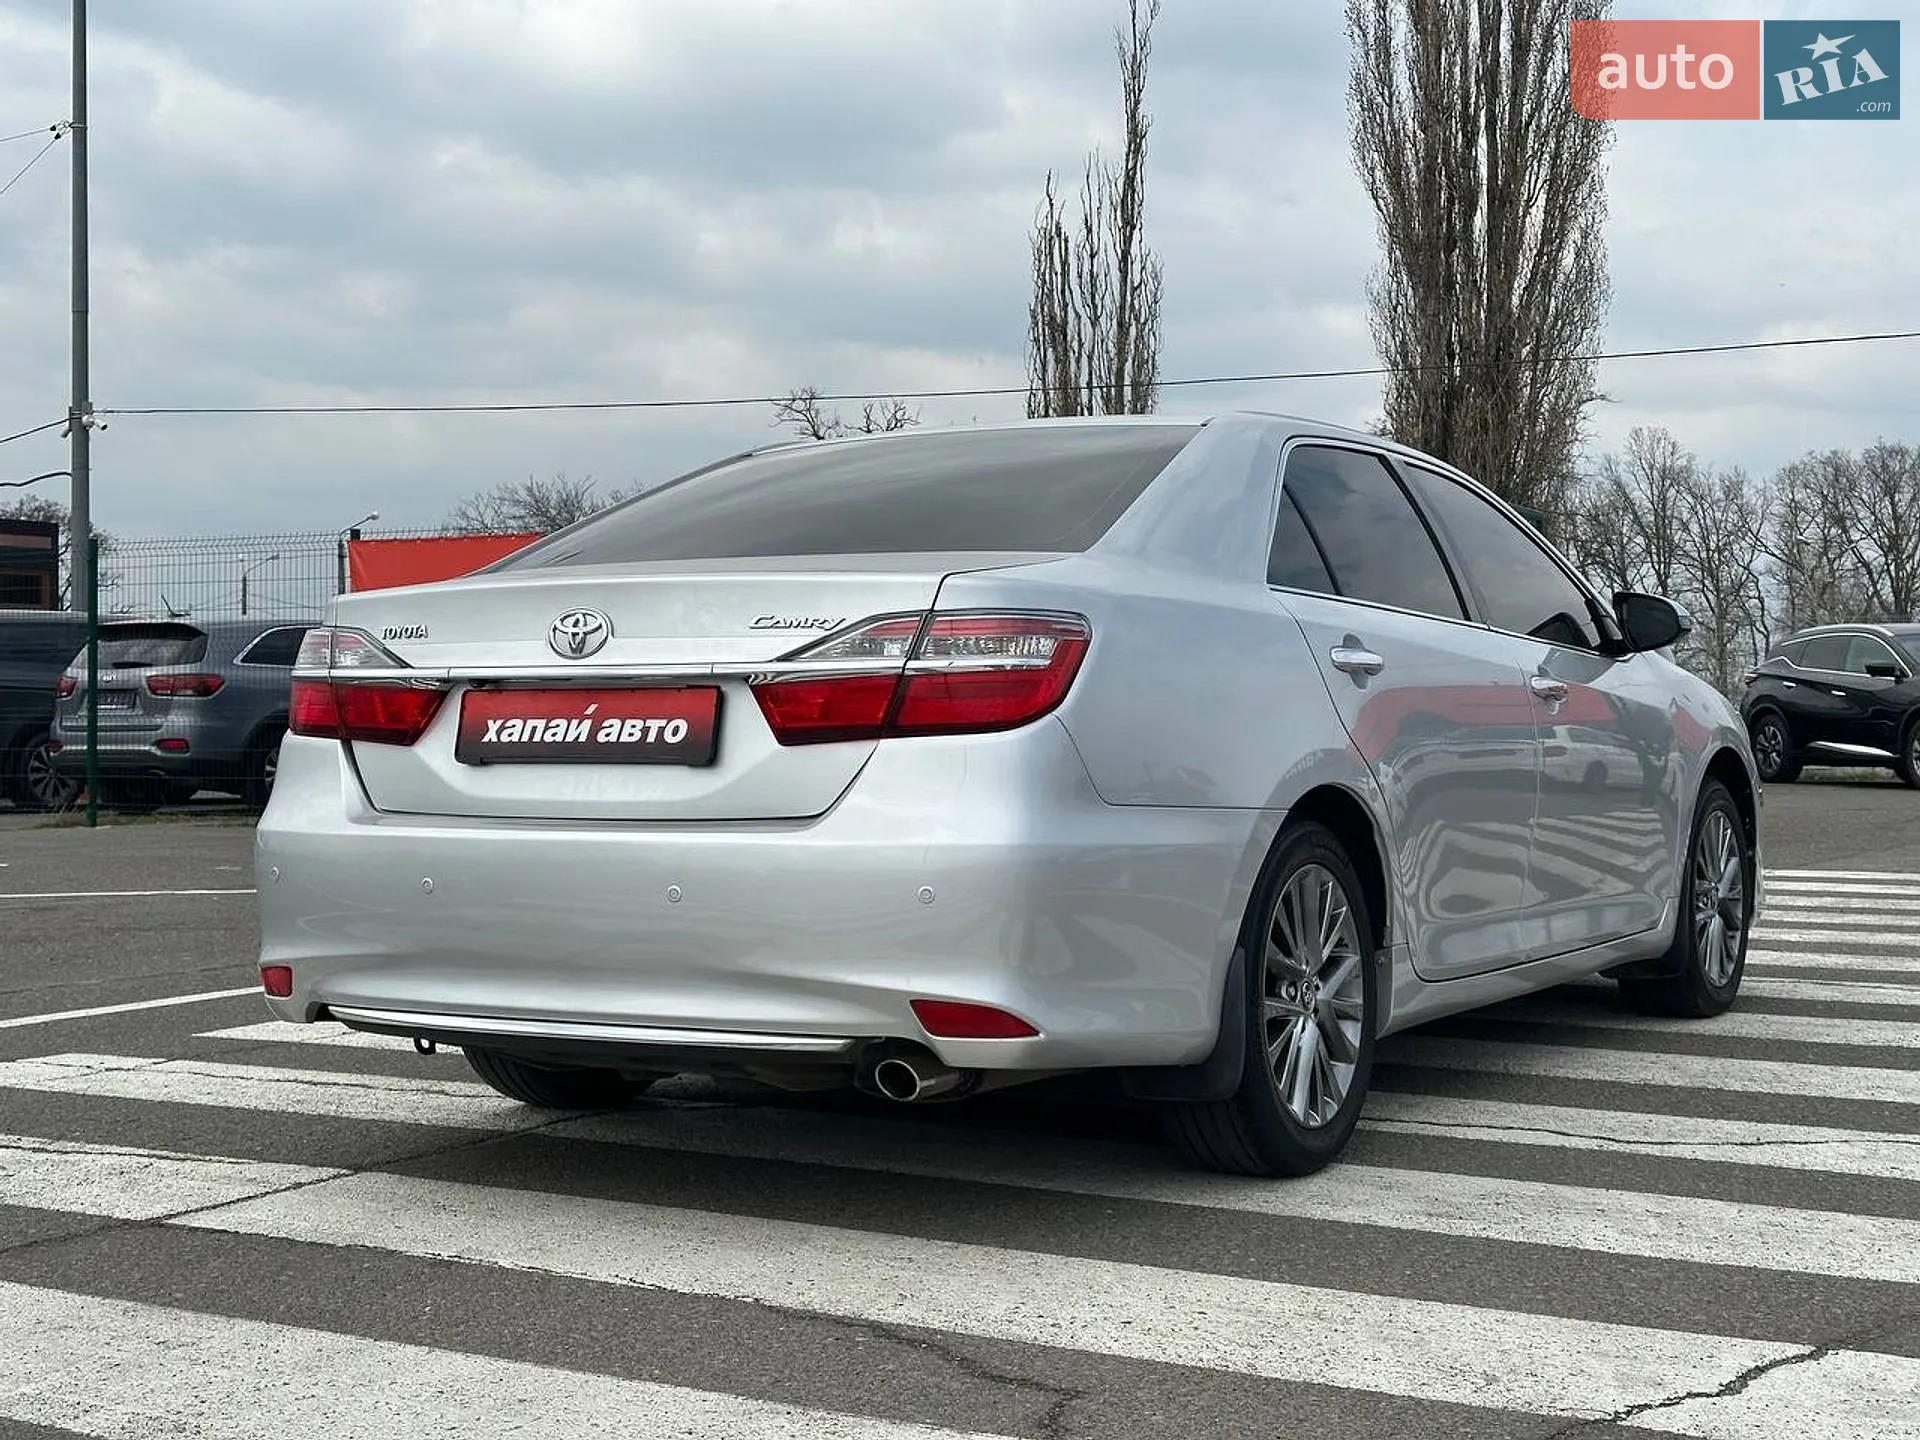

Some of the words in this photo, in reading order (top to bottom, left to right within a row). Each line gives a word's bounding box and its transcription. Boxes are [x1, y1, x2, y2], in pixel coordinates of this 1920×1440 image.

[382, 624, 429, 640] TOYOTA
[482, 703, 598, 743] хапай
[597, 718, 688, 744] авто
